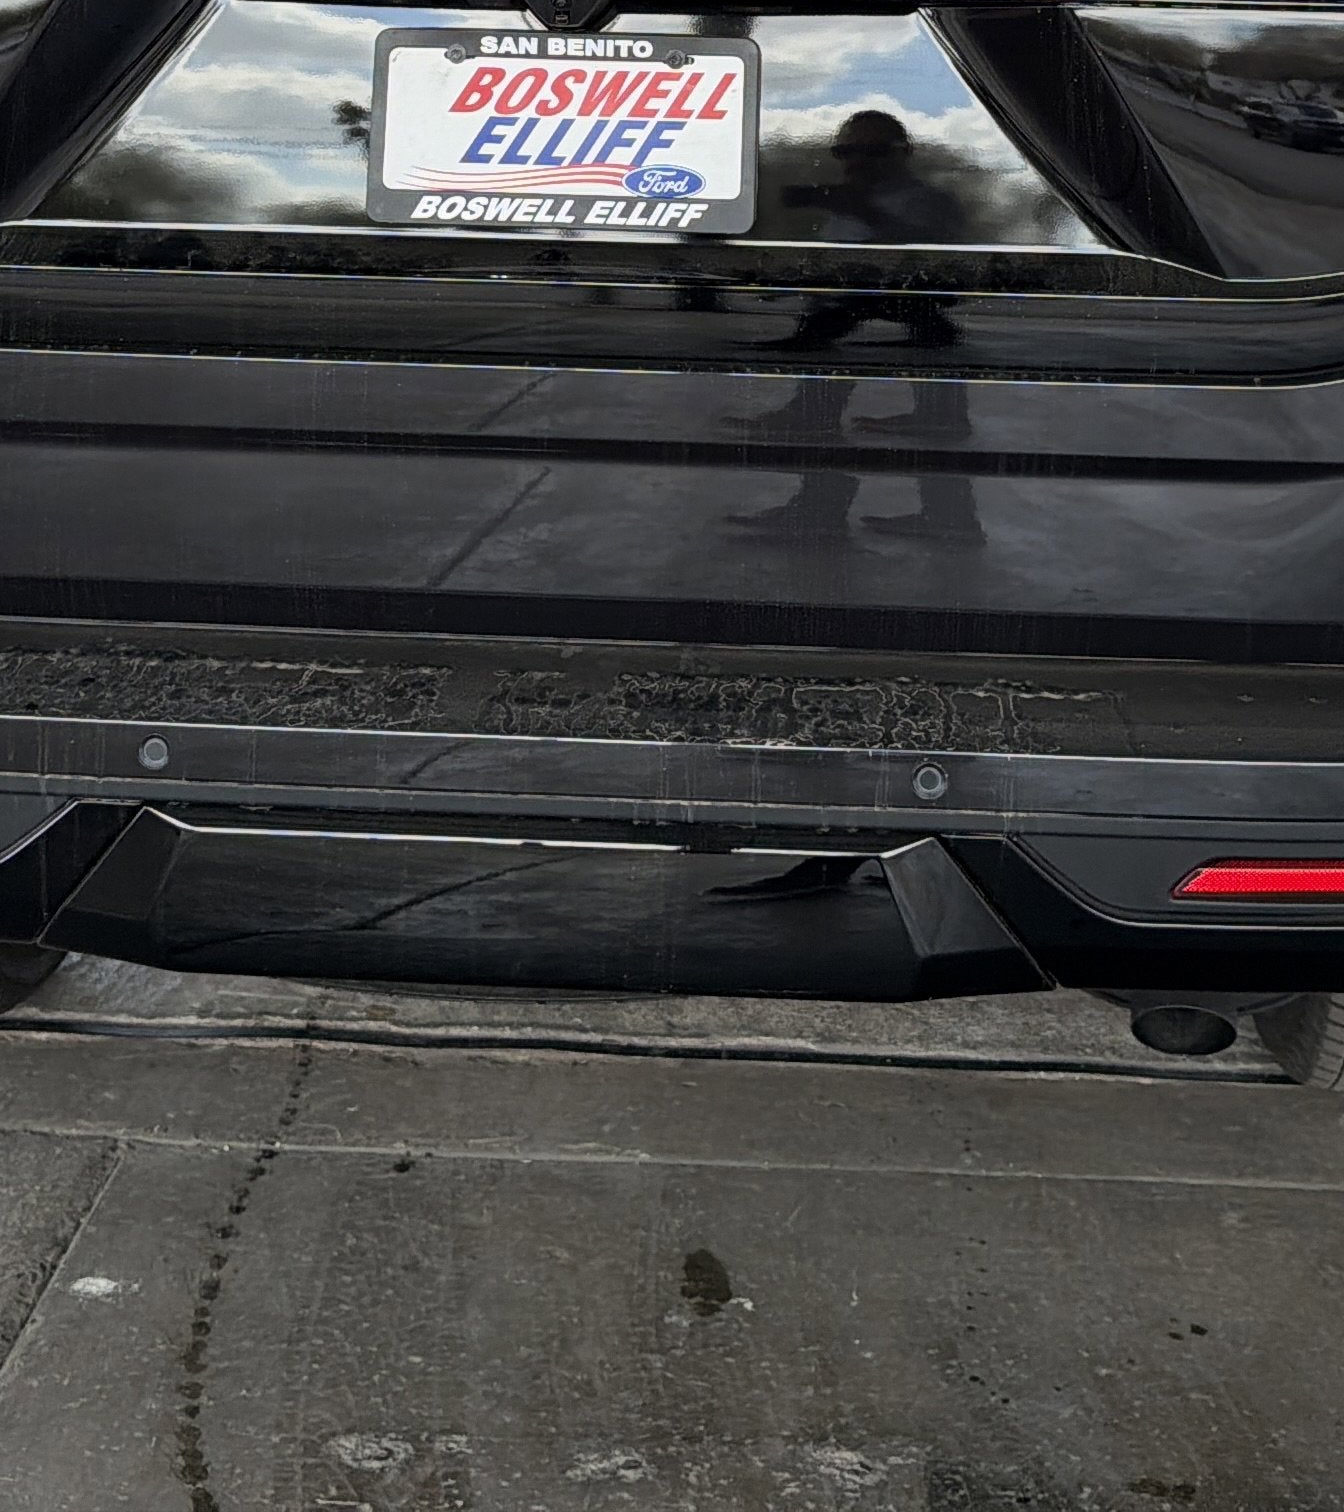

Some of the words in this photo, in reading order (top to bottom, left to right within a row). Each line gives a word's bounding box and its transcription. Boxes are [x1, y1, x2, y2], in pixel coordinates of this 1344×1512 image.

[480, 36, 538, 56] SAN
[547, 37, 654, 59] BENITO
[448, 66, 738, 120] BOSWELL
[458, 116, 688, 167] ELLIFF
[410, 195, 575, 225] BOSWELL
[583, 200, 709, 228] ELLIFF
